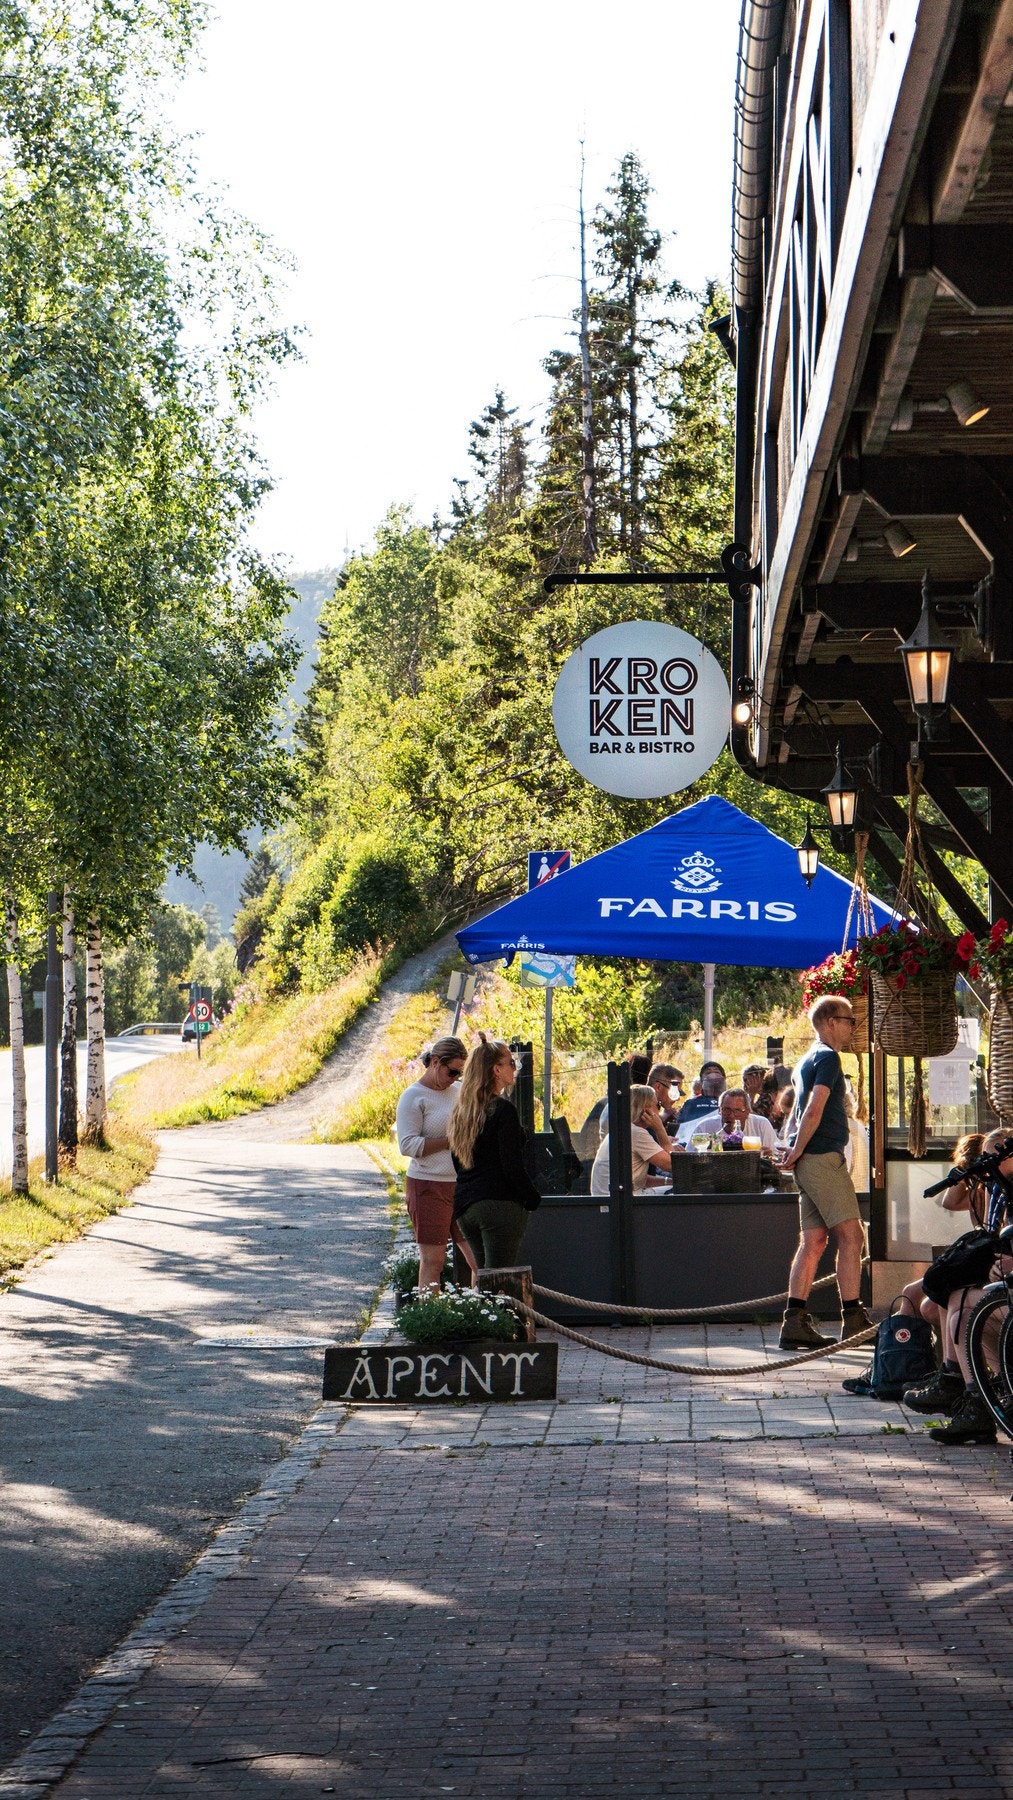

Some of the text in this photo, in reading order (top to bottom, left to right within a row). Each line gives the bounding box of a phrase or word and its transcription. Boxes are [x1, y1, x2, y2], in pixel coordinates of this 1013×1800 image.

[589, 657, 698, 695] KRO
[589, 698, 694, 736] KEN
[590, 742, 695, 753] BAR & BISTRO
[597, 897, 797, 922] FARRIS
[339, 1349, 540, 1399] ÅPENT
